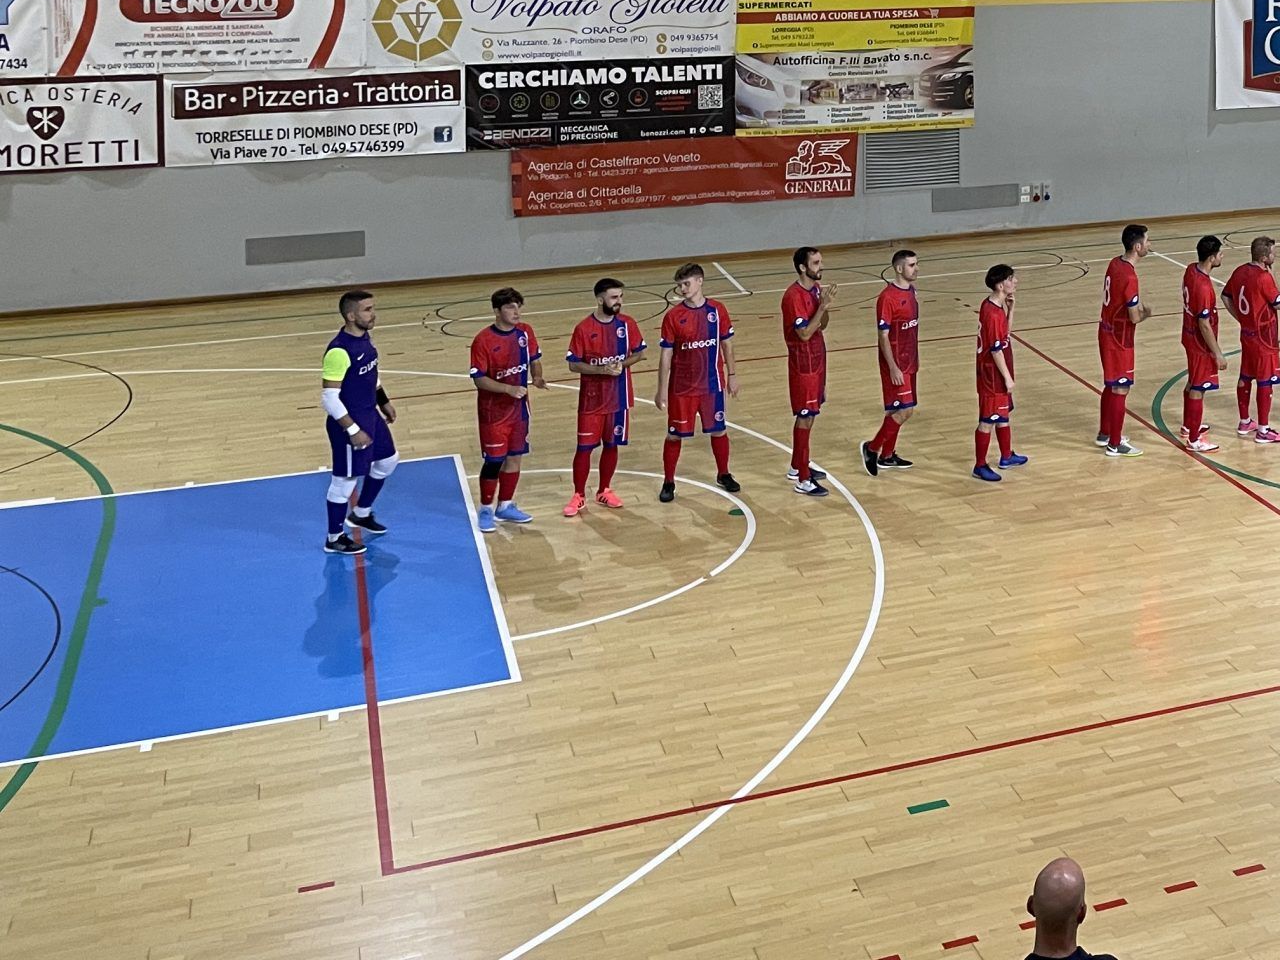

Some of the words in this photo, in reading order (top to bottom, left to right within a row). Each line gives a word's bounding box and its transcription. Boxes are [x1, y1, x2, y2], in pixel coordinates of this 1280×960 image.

[738, 1, 812, 10] SUPERMERCATI
[775, 13, 818, 22] ABBIAMO
[828, 12, 859, 20] CUORE
[892, 10, 920, 18] SPESA
[582, 26, 627, 34] ORAFO
[570, 37, 606, 45] Piombino
[630, 35, 648, 44] (PD)
[773, 56, 835, 66] Autofficina
[864, 53, 900, 64] Bavato
[904, 53, 932, 61] s.n.c.
[478, 67, 627, 89] CERCHIAMO
[632, 64, 723, 84] TALENTI
[48, 87, 143, 116] OSTERIA
[184, 88, 227, 111] Bar
[243, 84, 339, 108] Pizzeria
[353, 80, 454, 103] Trattoria
[195, 128, 274, 145] TORRESELLE
[277, 128, 290, 140] DI
[294, 125, 356, 140] PIOMBINO
[360, 124, 390, 136] DESE
[393, 121, 418, 136] (PD)
[560, 125, 609, 133] MECCANICA
[571, 132, 618, 141] PRECISIONE
[641, 129, 686, 137] benozzi.com
[210, 147, 231, 160] Via
[234, 147, 267, 159] Piave
[270, 146, 287, 158] 70
[321, 140, 404, 154] 049.5746399
[528, 161, 573, 173] Agenzia
[576, 160, 587, 169] di
[590, 155, 660, 168] Castelfranco
[663, 152, 700, 163] Veneto
[528, 190, 573, 203] Agenzia
[577, 188, 587, 198] di
[590, 185, 642, 198] Cittadella
[784, 178, 852, 195] GENERALI
[1238, 285, 1250, 315] 6
[688, 339, 716, 349] LEGOR
